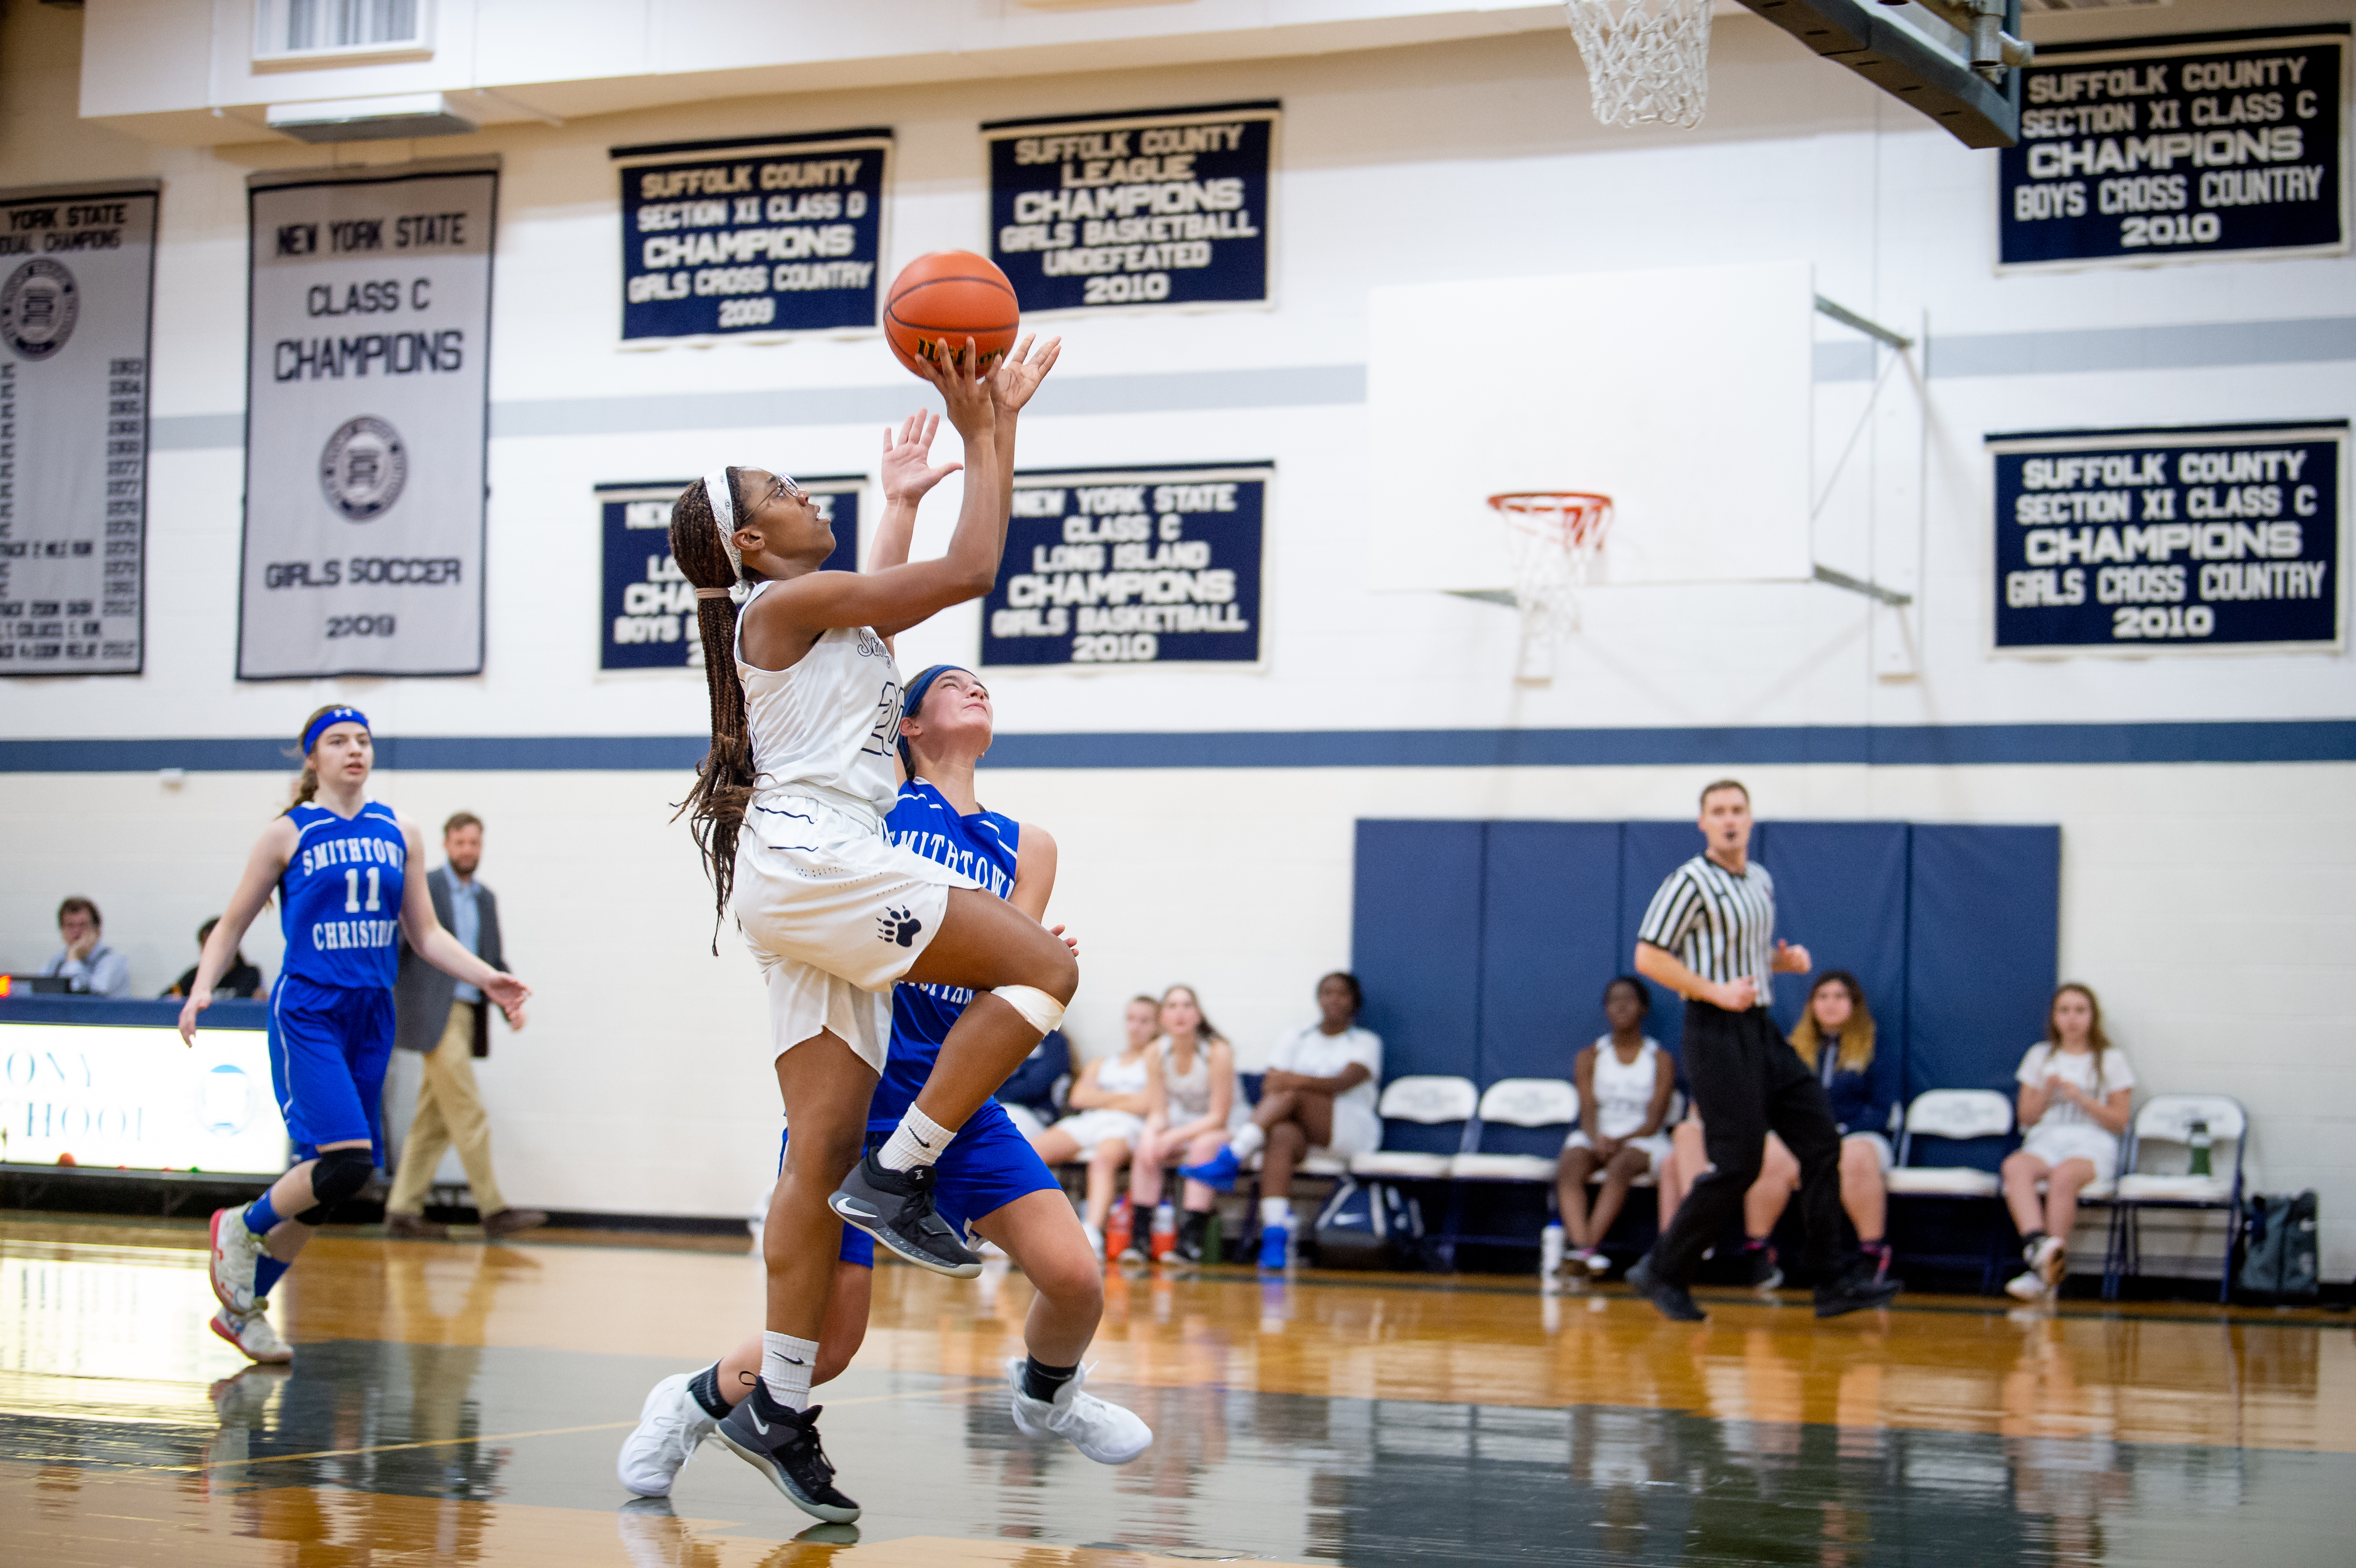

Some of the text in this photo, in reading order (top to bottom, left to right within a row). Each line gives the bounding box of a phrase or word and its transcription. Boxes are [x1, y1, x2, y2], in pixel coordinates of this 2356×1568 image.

[2028, 56, 2307, 103] SUFFOLK COUNTY
[2022, 90, 2317, 138] SECTION XI CLASS C
[1014, 125, 1243, 164] SUFFOLK COUNTY
[2028, 126, 2303, 178] CHAMPIONS
[641, 159, 861, 198] SUFFOLK COUNTY
[1061, 155, 1196, 188] LEAGUE
[637, 191, 866, 231] SECTION XI CLASS D
[1014, 178, 1243, 224] CHAMPIONS
[2015, 165, 2324, 221] BOYS CROSS COUNTRY
[9, 204, 127, 231] YORK STATE
[277, 212, 466, 256] NEW YORK STATE
[1000, 211, 1258, 252] GIRLS BASKETBALL
[2120, 213, 2220, 247] 2010
[643, 225, 854, 268] CHAMPIONS
[1043, 241, 1211, 277] UNDEFEATED
[307, 277, 430, 317] CLASS C
[629, 261, 873, 303] GIRLS CROSS COUNTRY
[1083, 273, 1169, 305] 2010
[275, 329, 463, 381] CHAMPIONS
[2023, 450, 2305, 490] SUFFOLK COUNTY
[626, 502, 672, 529] NE
[1011, 483, 1237, 518] NEW YORK STATE
[2016, 485, 2316, 525] SECTION XI CLASS C
[1063, 514, 1181, 543] CLASS C
[2026, 522, 2302, 566] CHAMPIONS
[265, 557, 460, 589] GIRLS SOCCER
[1033, 541, 1210, 573] LONG ISLAND
[1008, 570, 1236, 608] CHAMPIONS
[2007, 561, 2325, 607] GIRLS CROSS COUNTRY
[614, 616, 679, 644] BOYS
[992, 604, 1248, 637] GIRLS BASKETBALL
[2113, 606, 2214, 638] 2010
[1071, 634, 1157, 662] 2010
[345, 867, 380, 913] 11
